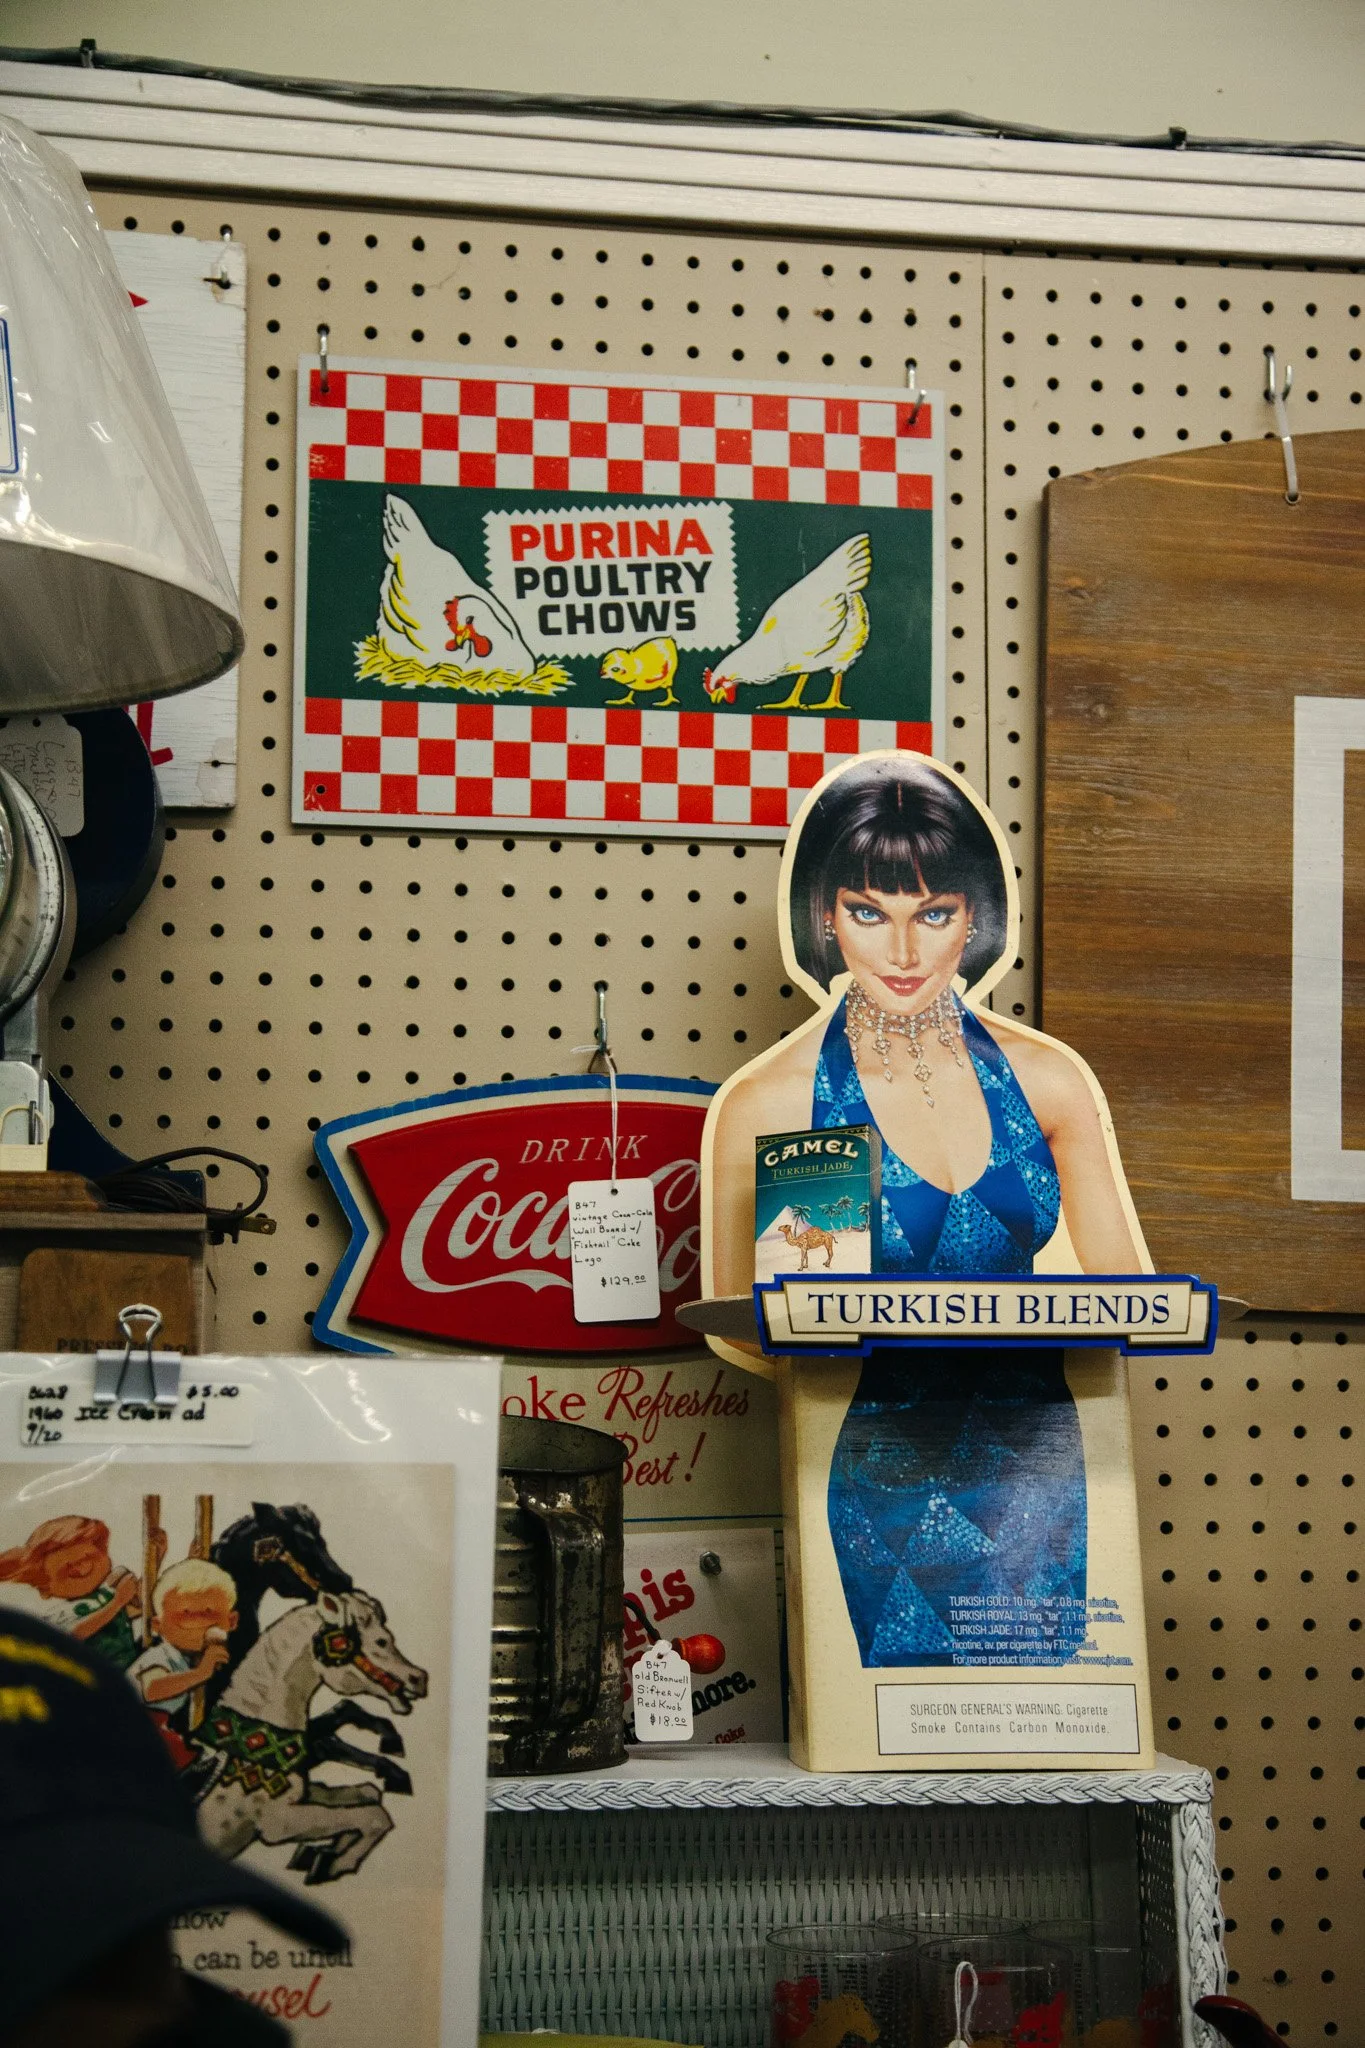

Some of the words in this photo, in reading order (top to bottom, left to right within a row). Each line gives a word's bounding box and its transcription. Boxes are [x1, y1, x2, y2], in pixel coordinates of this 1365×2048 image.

[510, 518, 714, 562] PURINA
[514, 560, 712, 599] POULTRY
[538, 600, 696, 635] CHOWS
[519, 1135, 648, 1164] DRINK
[764, 1138, 859, 1167] CAMEL
[771, 1164, 820, 1180] TURKISH
[821, 1161, 853, 1175] JADE
[575, 1201, 597, 1210] B47
[574, 1254, 602, 1266] Logo
[808, 1292, 1001, 1326] TURKISH
[1014, 1293, 1171, 1327] BLENDS
[501, 1375, 587, 1421] oke
[597, 1365, 750, 1443] Refreshes
[949, 1595, 985, 1607] TURKISH
[950, 1610, 986, 1621] TURKISH
[951, 1624, 987, 1636] TURKISH
[1053, 1639, 1069, 1650] FTC
[645, 1660, 668, 1670] B47
[952, 1654, 965, 1665] For
[966, 1656, 988, 1666] more
[988, 1654, 1018, 1667] product
[634, 1671, 651, 1681] old
[637, 1698, 656, 1708] Red
[909, 1703, 958, 1716] SURGEON
[960, 1703, 1013, 1716] GENERAL'S
[1015, 1703, 1063, 1716] WARNING:
[1065, 1703, 1109, 1718] Cigarette
[910, 1721, 947, 1734] Smoke
[954, 1721, 1002, 1734] Contains
[1008, 1721, 1049, 1734] Carbon
[1055, 1721, 1110, 1734] Monoxide.
[193, 1951, 242, 1970] can
[247, 1939, 280, 1969] be
